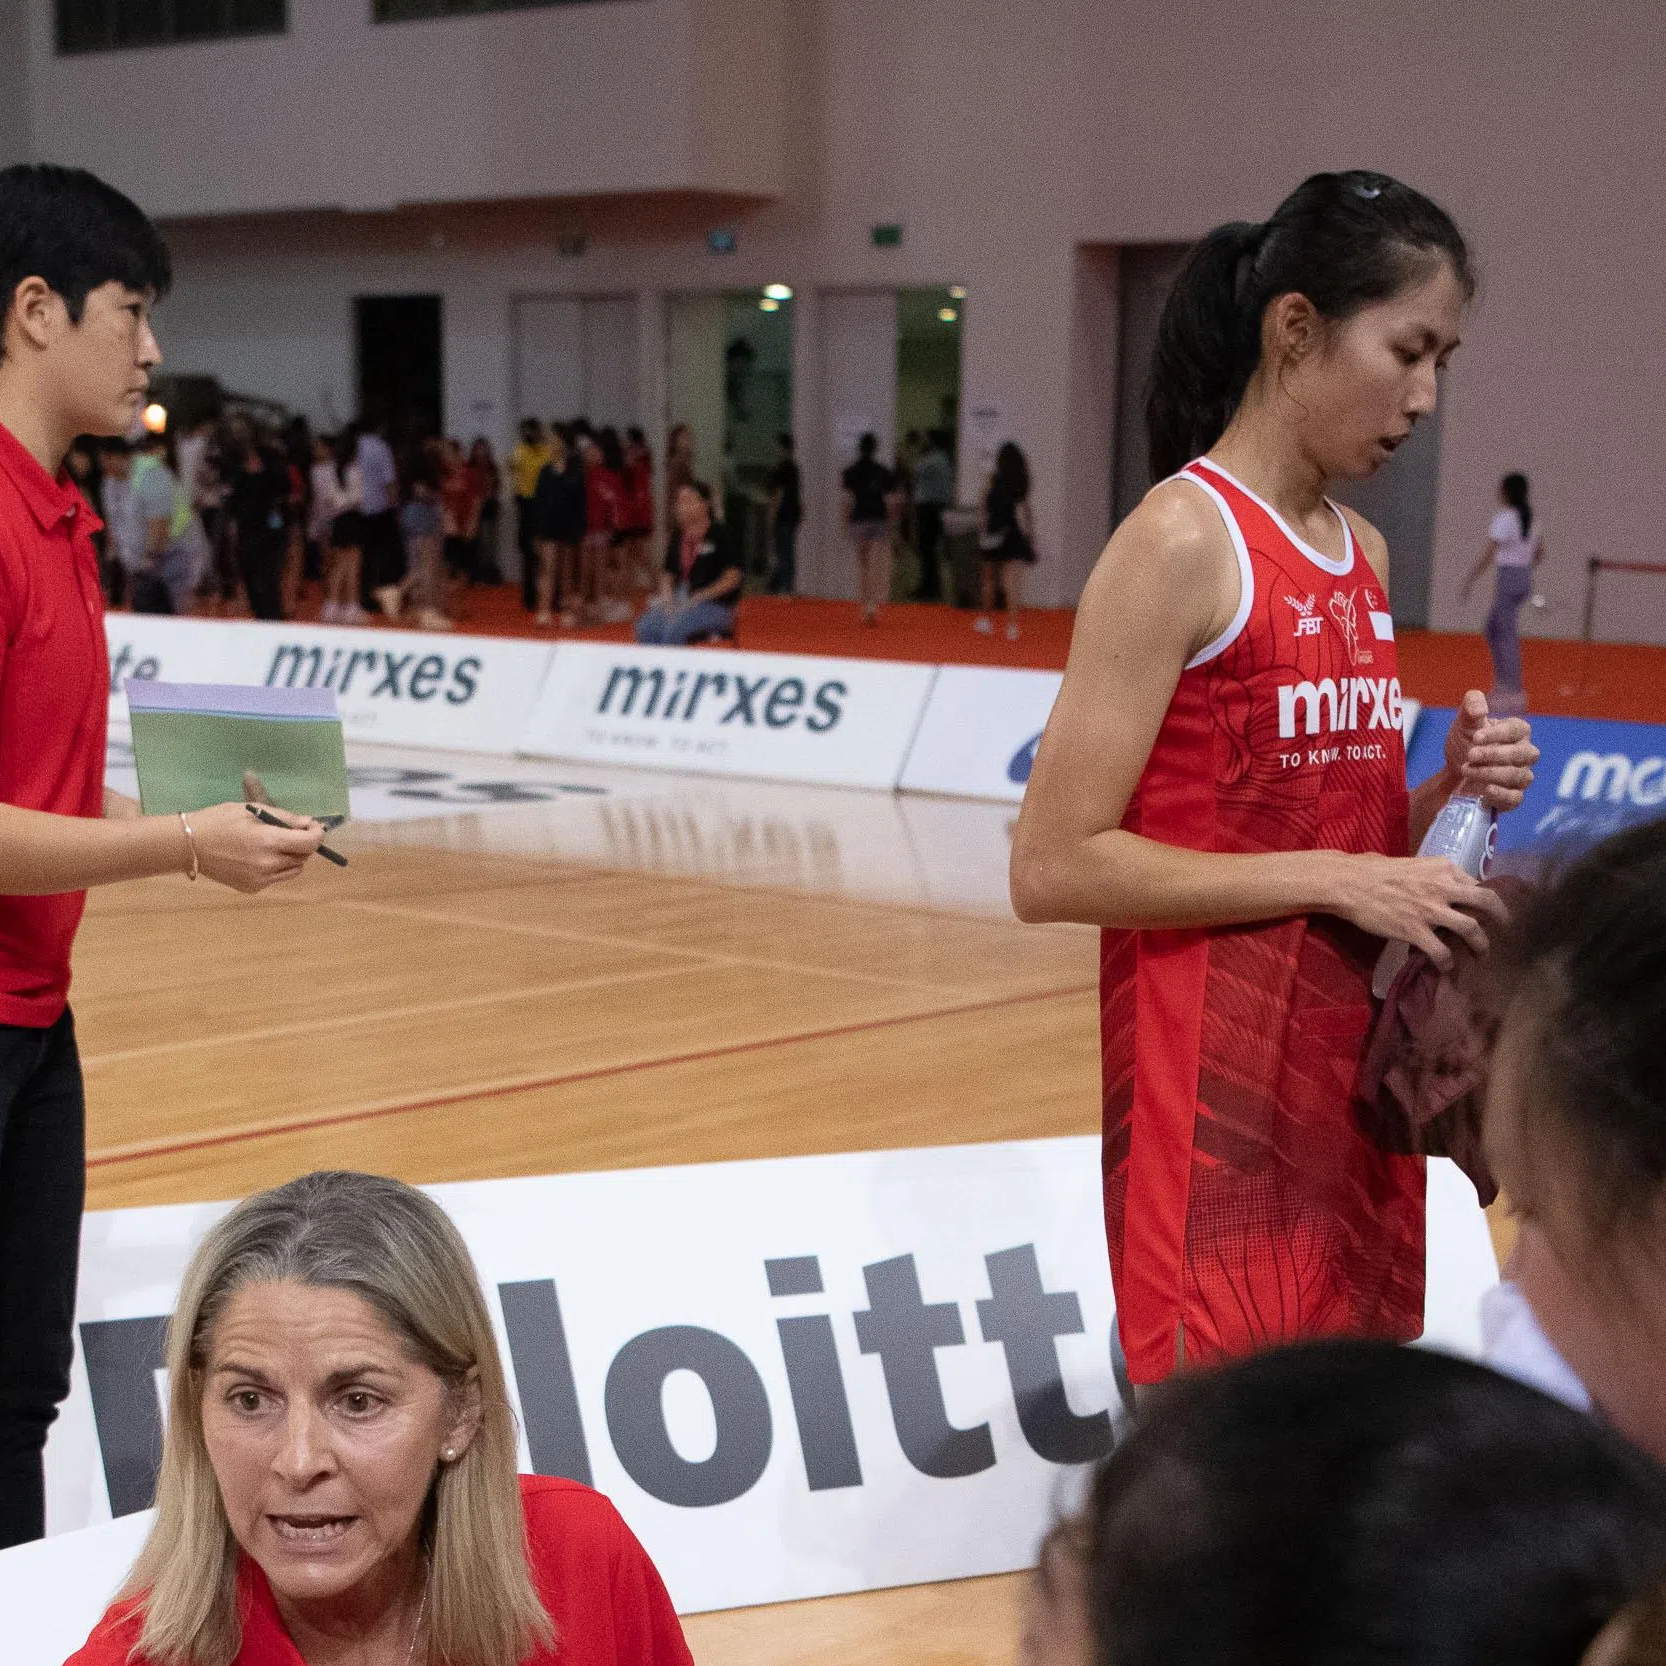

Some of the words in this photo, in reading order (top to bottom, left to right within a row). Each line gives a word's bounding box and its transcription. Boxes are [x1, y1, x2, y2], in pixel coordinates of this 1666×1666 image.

[1293, 617, 1325, 637] FBT
[264, 642, 482, 705] mirxes
[597, 665, 849, 734] mirxes
[1280, 753, 1300, 768] TO
[1347, 745, 1361, 760] TO
